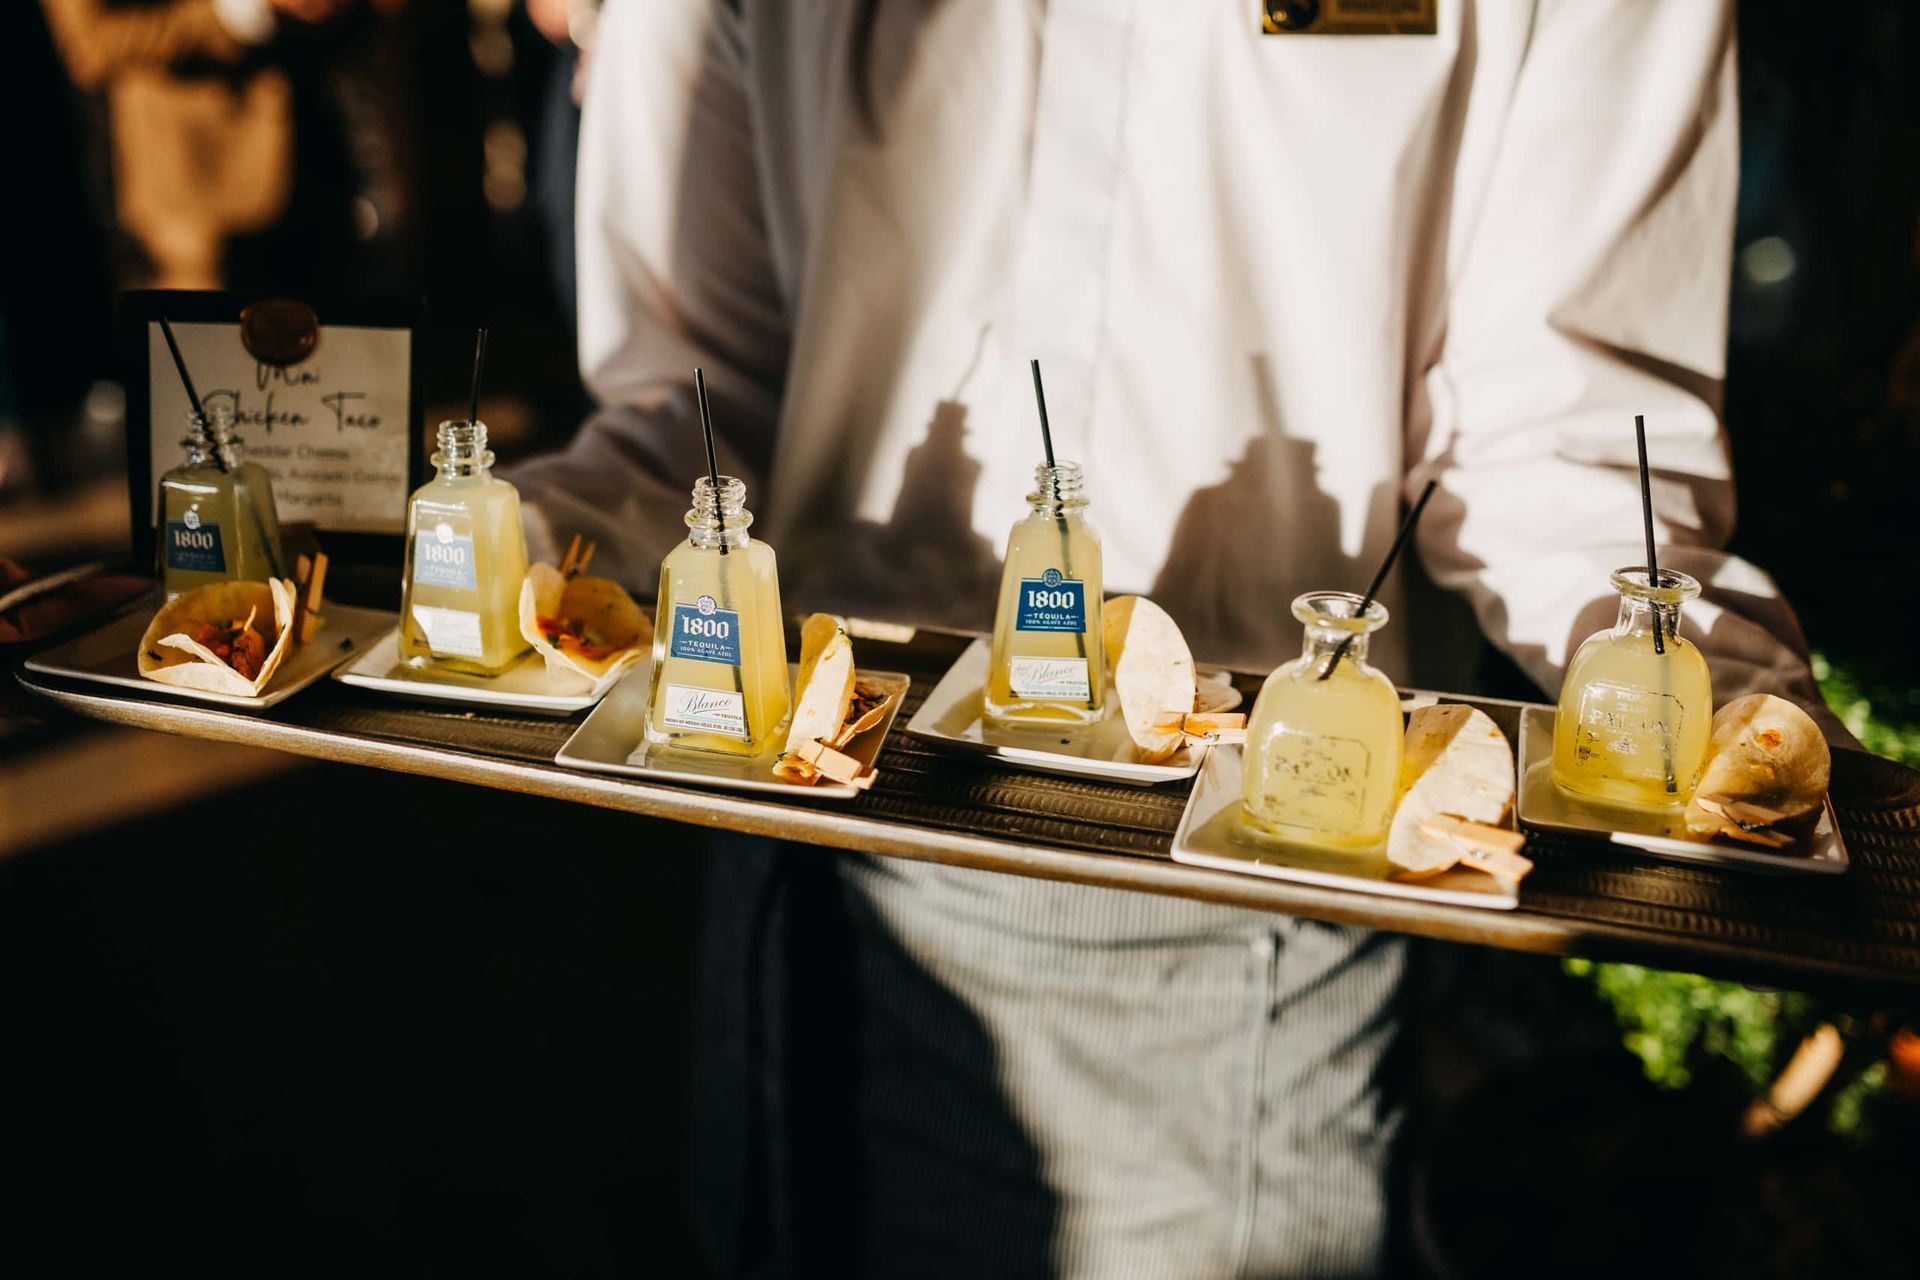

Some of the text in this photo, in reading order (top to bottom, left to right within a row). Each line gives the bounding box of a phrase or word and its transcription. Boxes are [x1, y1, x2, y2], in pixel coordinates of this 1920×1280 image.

[320, 390, 382, 432] Taco
[174, 529, 213, 550] 1800
[424, 543, 465, 565] 1800
[1027, 590, 1075, 609] 1800
[681, 614, 729, 639] 1800
[1033, 612, 1071, 620] TEQUILA
[688, 640, 725, 651] TEQUILA
[677, 690, 732, 714] Blanco
